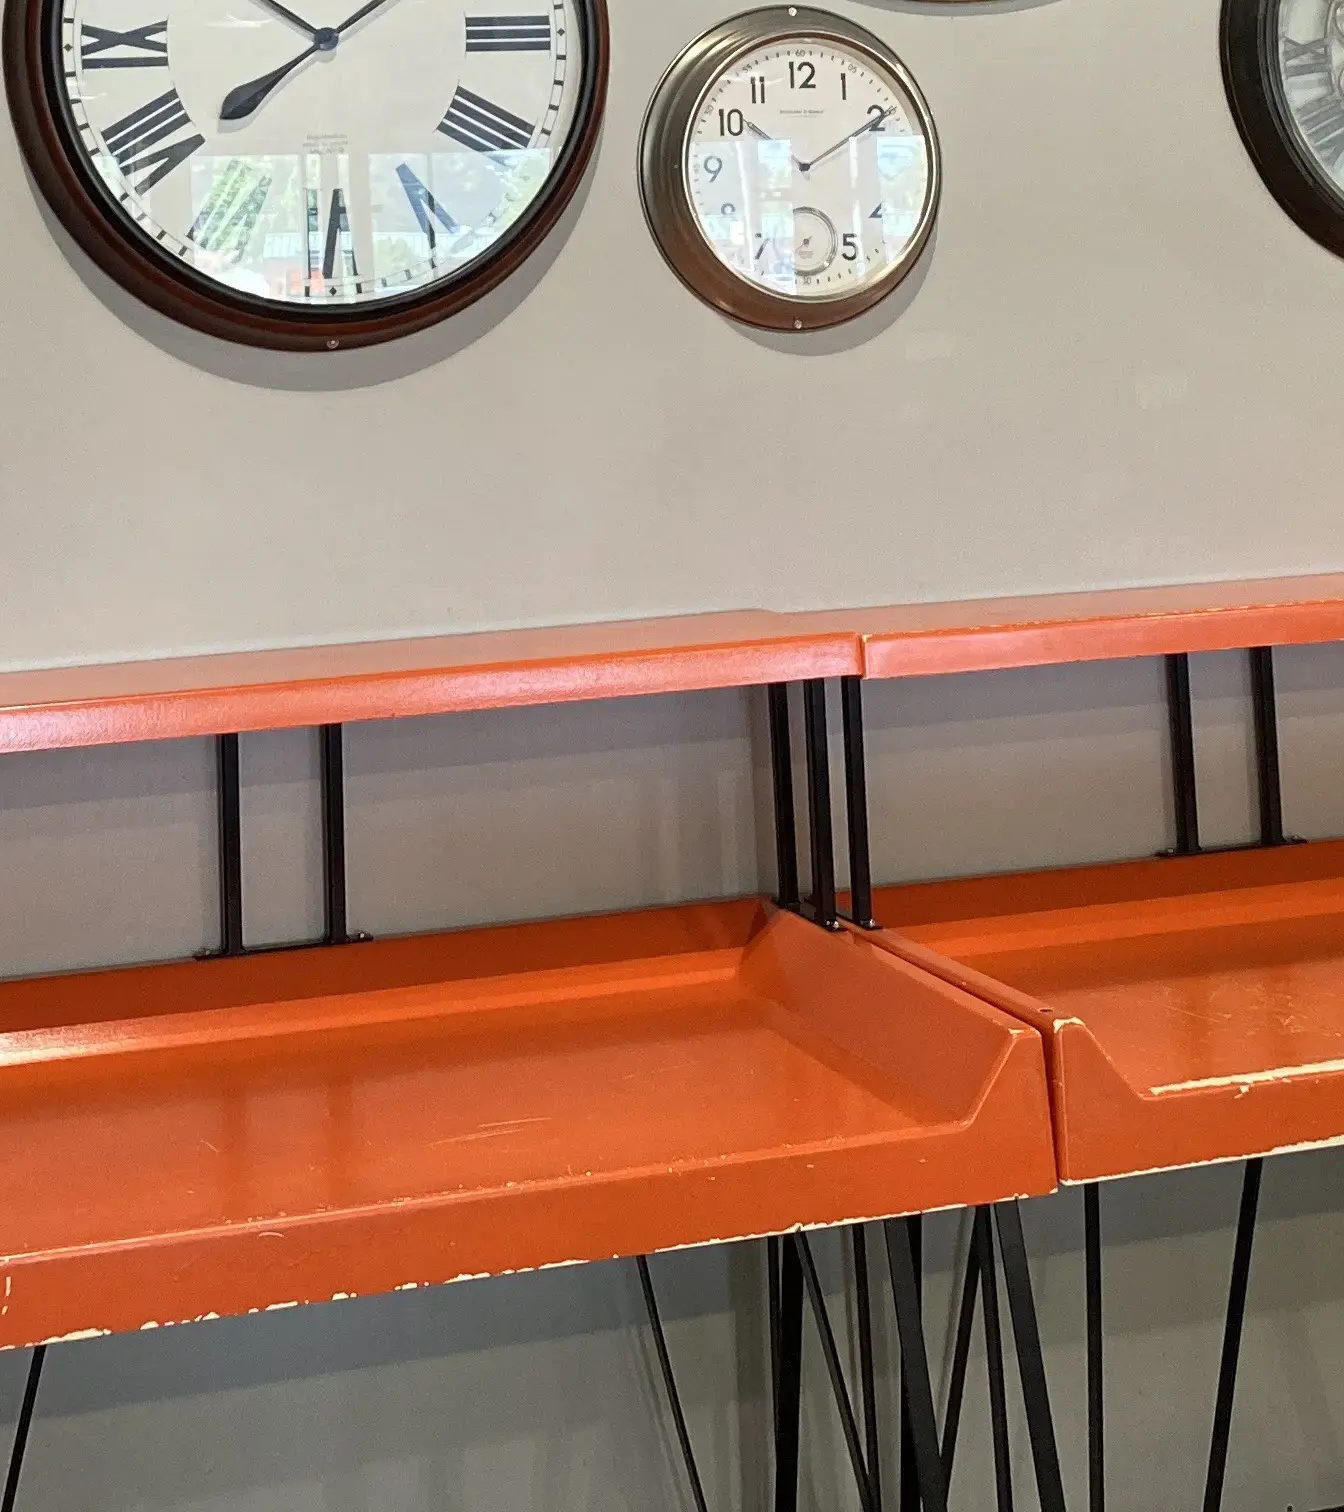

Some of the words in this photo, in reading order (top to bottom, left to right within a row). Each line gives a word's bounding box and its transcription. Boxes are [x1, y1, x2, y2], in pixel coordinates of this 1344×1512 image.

[80, 20, 169, 70] IX
[464, 14, 551, 57] III
[788, 61, 816, 89] 12
[840, 73, 847, 100] 1
[750, 76, 765, 104] 11
[719, 108, 744, 137] 10
[866, 105, 885, 131] 2
[99, 87, 207, 195] VIII
[703, 156, 722, 183] 9
[842, 233, 857, 261] 5
